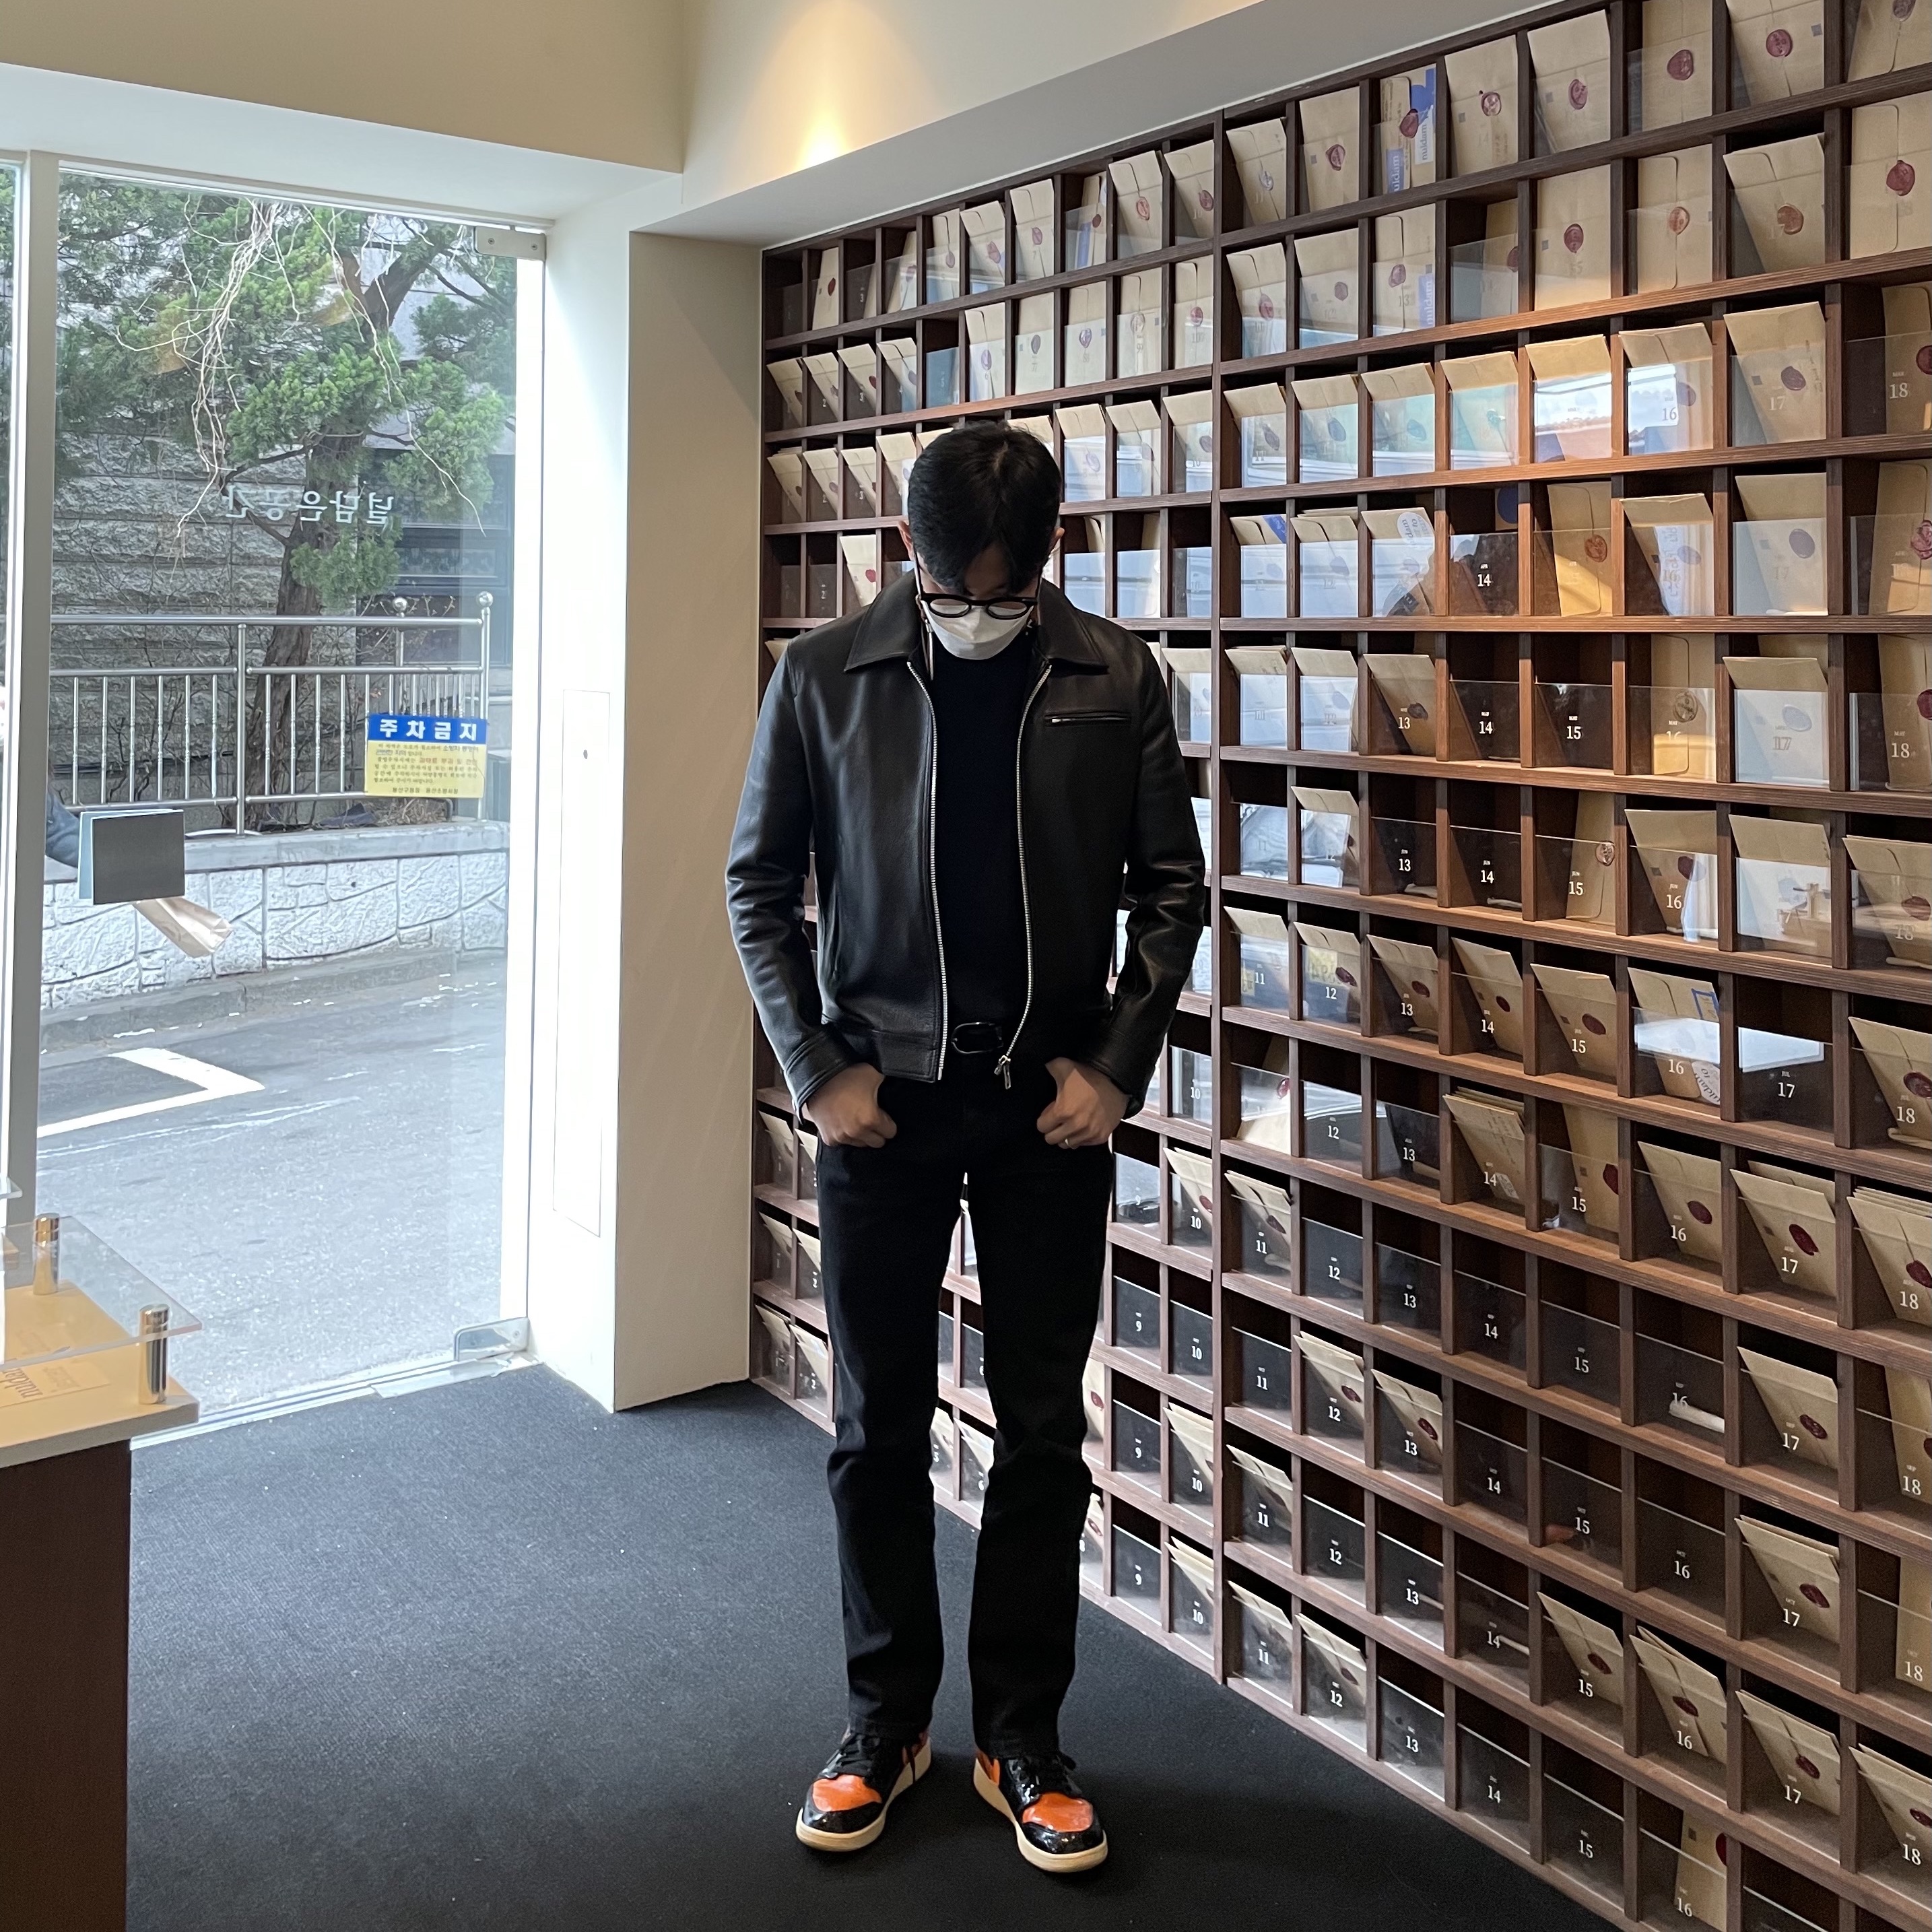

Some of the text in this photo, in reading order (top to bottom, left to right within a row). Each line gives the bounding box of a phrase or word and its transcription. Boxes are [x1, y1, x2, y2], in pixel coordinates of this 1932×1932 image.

[1420, 124, 1428, 161] nuldam
[1392, 156, 1400, 192] uldam
[1426, 280, 1434, 327] nuldam
[1890, 382, 1908, 399] 18
[1769, 396, 1786, 411] 17
[1662, 407, 1677, 421] 16
[1477, 574, 1491, 587] 14
[380, 719, 477, 741] 주차금지
[1399, 717, 1410, 729] 13
[1479, 721, 1493, 735] 14
[1566, 725, 1581, 739] 15
[1891, 743, 1910, 758] 18
[1399, 859, 1411, 872] 13
[1481, 870, 1494, 884] 14
[1569, 881, 1583, 896] 15
[1667, 895, 1681, 909] 16
[1255, 972, 1265, 985] 11
[1325, 987, 1336, 999] 12
[1401, 1003, 1413, 1016] 13
[1481, 1020, 1494, 1034] 14
[1572, 1039, 1586, 1053] 15
[1668, 1059, 1684, 1074] 16
[1191, 1088, 1201, 1099] 10
[1695, 1073, 1720, 1102] uldam
[1778, 1082, 1795, 1098] 17
[1897, 1106, 1915, 1123] 18
[1328, 1125, 1339, 1139] 12
[1403, 1147, 1415, 1161] 13
[1484, 1172, 1497, 1186] 14
[1135, 1195, 1141, 1205] 9
[1572, 1197, 1587, 1211] 15
[1191, 1216, 1201, 1230] 10
[1671, 1225, 1686, 1242] 16
[1256, 1240, 1267, 1254] 11
[1329, 1265, 1340, 1280] 12
[1781, 1257, 1798, 1273] 17
[1404, 1294, 1416, 1308] 13
[1900, 1292, 1919, 1309] 18
[1135, 1320, 1142, 1332] 9
[1484, 1323, 1498, 1339] 14
[1191, 1346, 1202, 1360] 10
[1574, 1356, 1589, 1373] 15
[1257, 1375, 1267, 1390] 11
[1329, 1406, 1340, 1422] 12
[1405, 1440, 1418, 1456] 13
[1782, 1433, 1799, 1450] 17
[1135, 1447, 1142, 1459] 9
[978, 1479, 985, 1491] 6
[1192, 1478, 1203, 1492] 10
[1487, 1477, 1501, 1494] 14
[1902, 1477, 1921, 1494] 18
[1258, 1511, 1269, 1527] 11
[1574, 1517, 1590, 1534] 15
[1329, 1549, 1341, 1565] 12
[1674, 1560, 1690, 1578] 16
[1135, 1573, 1142, 1585] 9
[1406, 1589, 1419, 1605] 13
[1193, 1609, 1203, 1624] 10
[1783, 1609, 1801, 1627] 17
[1487, 1631, 1501, 1648] 14
[1258, 1648, 1269, 1665] 11
[1905, 1661, 1923, 1681] 18
[1578, 1678, 1593, 1697] 15
[1330, 1690, 1343, 1707] 12
[1406, 1735, 1419, 1752] 13
[1676, 1730, 1692, 1749] 16
[1488, 1785, 1501, 1803] 14
[1785, 1785, 1802, 1804] 17
[1578, 1840, 1593, 1858] 15
[1902, 1843, 1921, 1865] 18
[1677, 1898, 1693, 1917] 16
